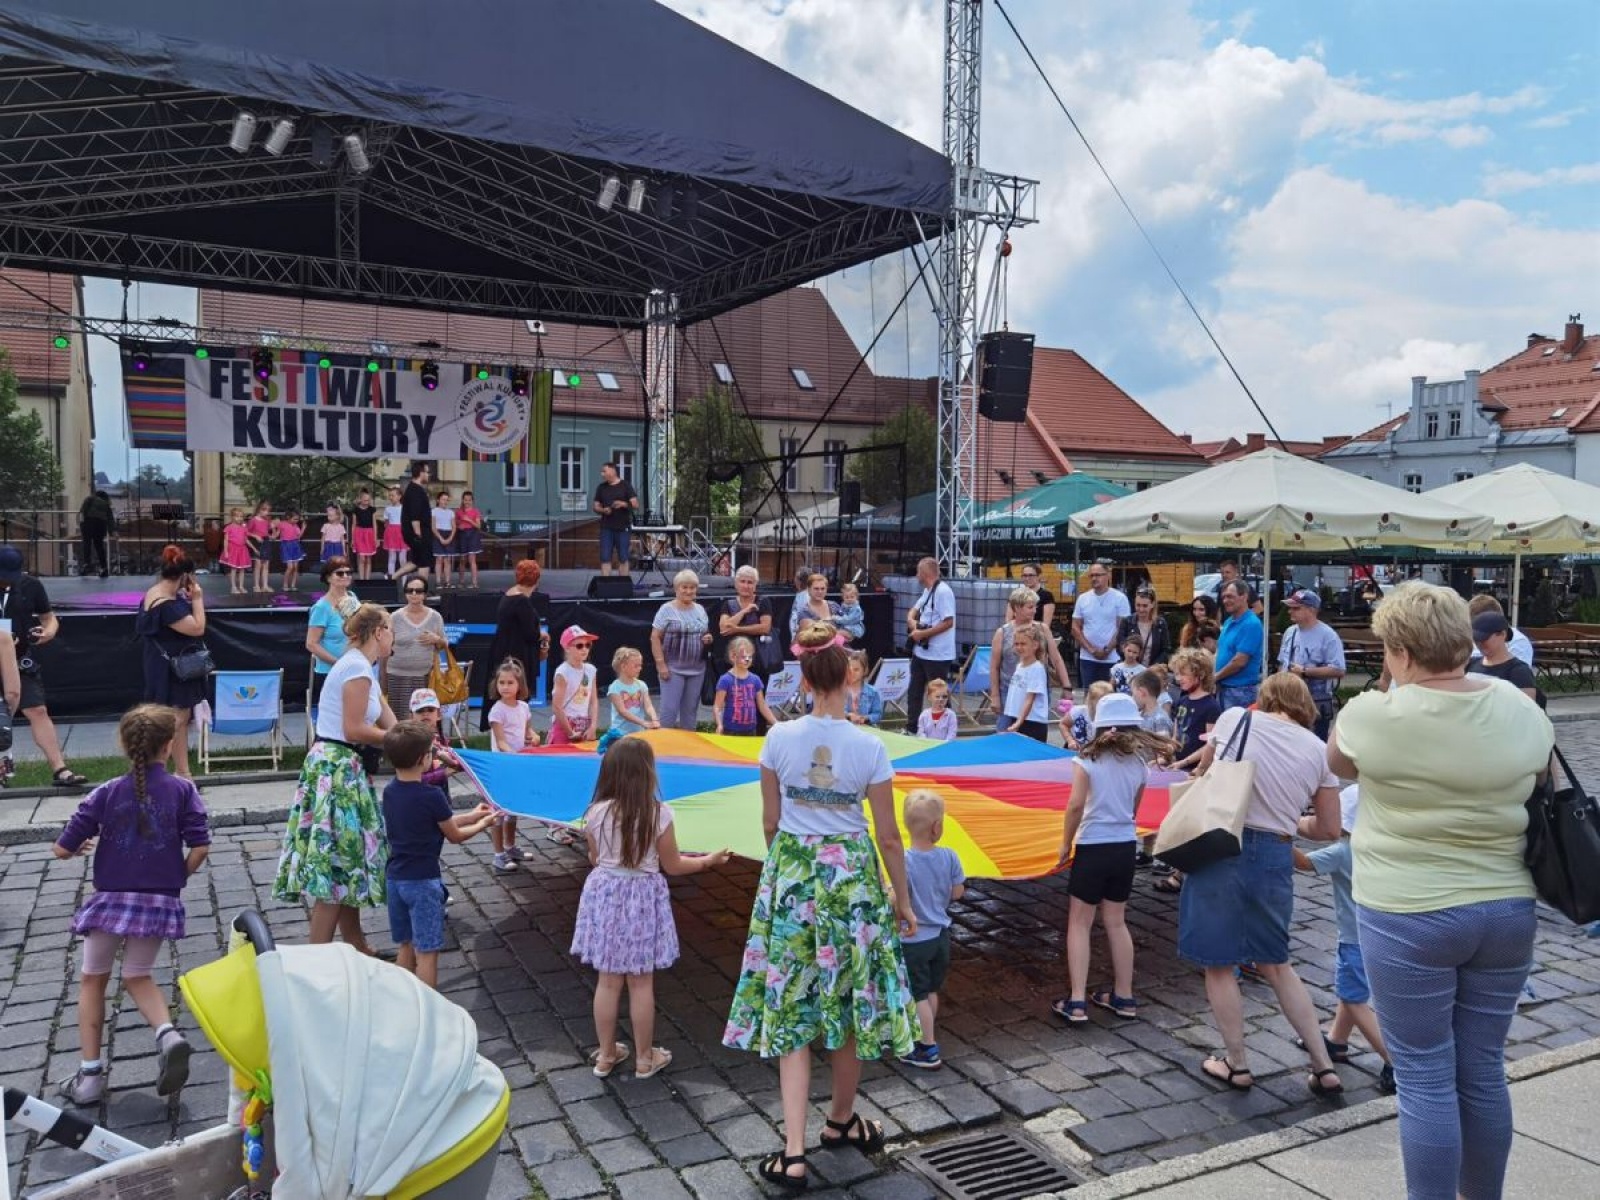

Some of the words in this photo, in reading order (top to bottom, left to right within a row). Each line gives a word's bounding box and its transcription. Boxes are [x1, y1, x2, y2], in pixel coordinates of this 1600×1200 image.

[209, 359, 403, 409] FESTIWAL
[460, 382, 493, 411] FESTIWAL
[232, 405, 437, 454] KULTURY
